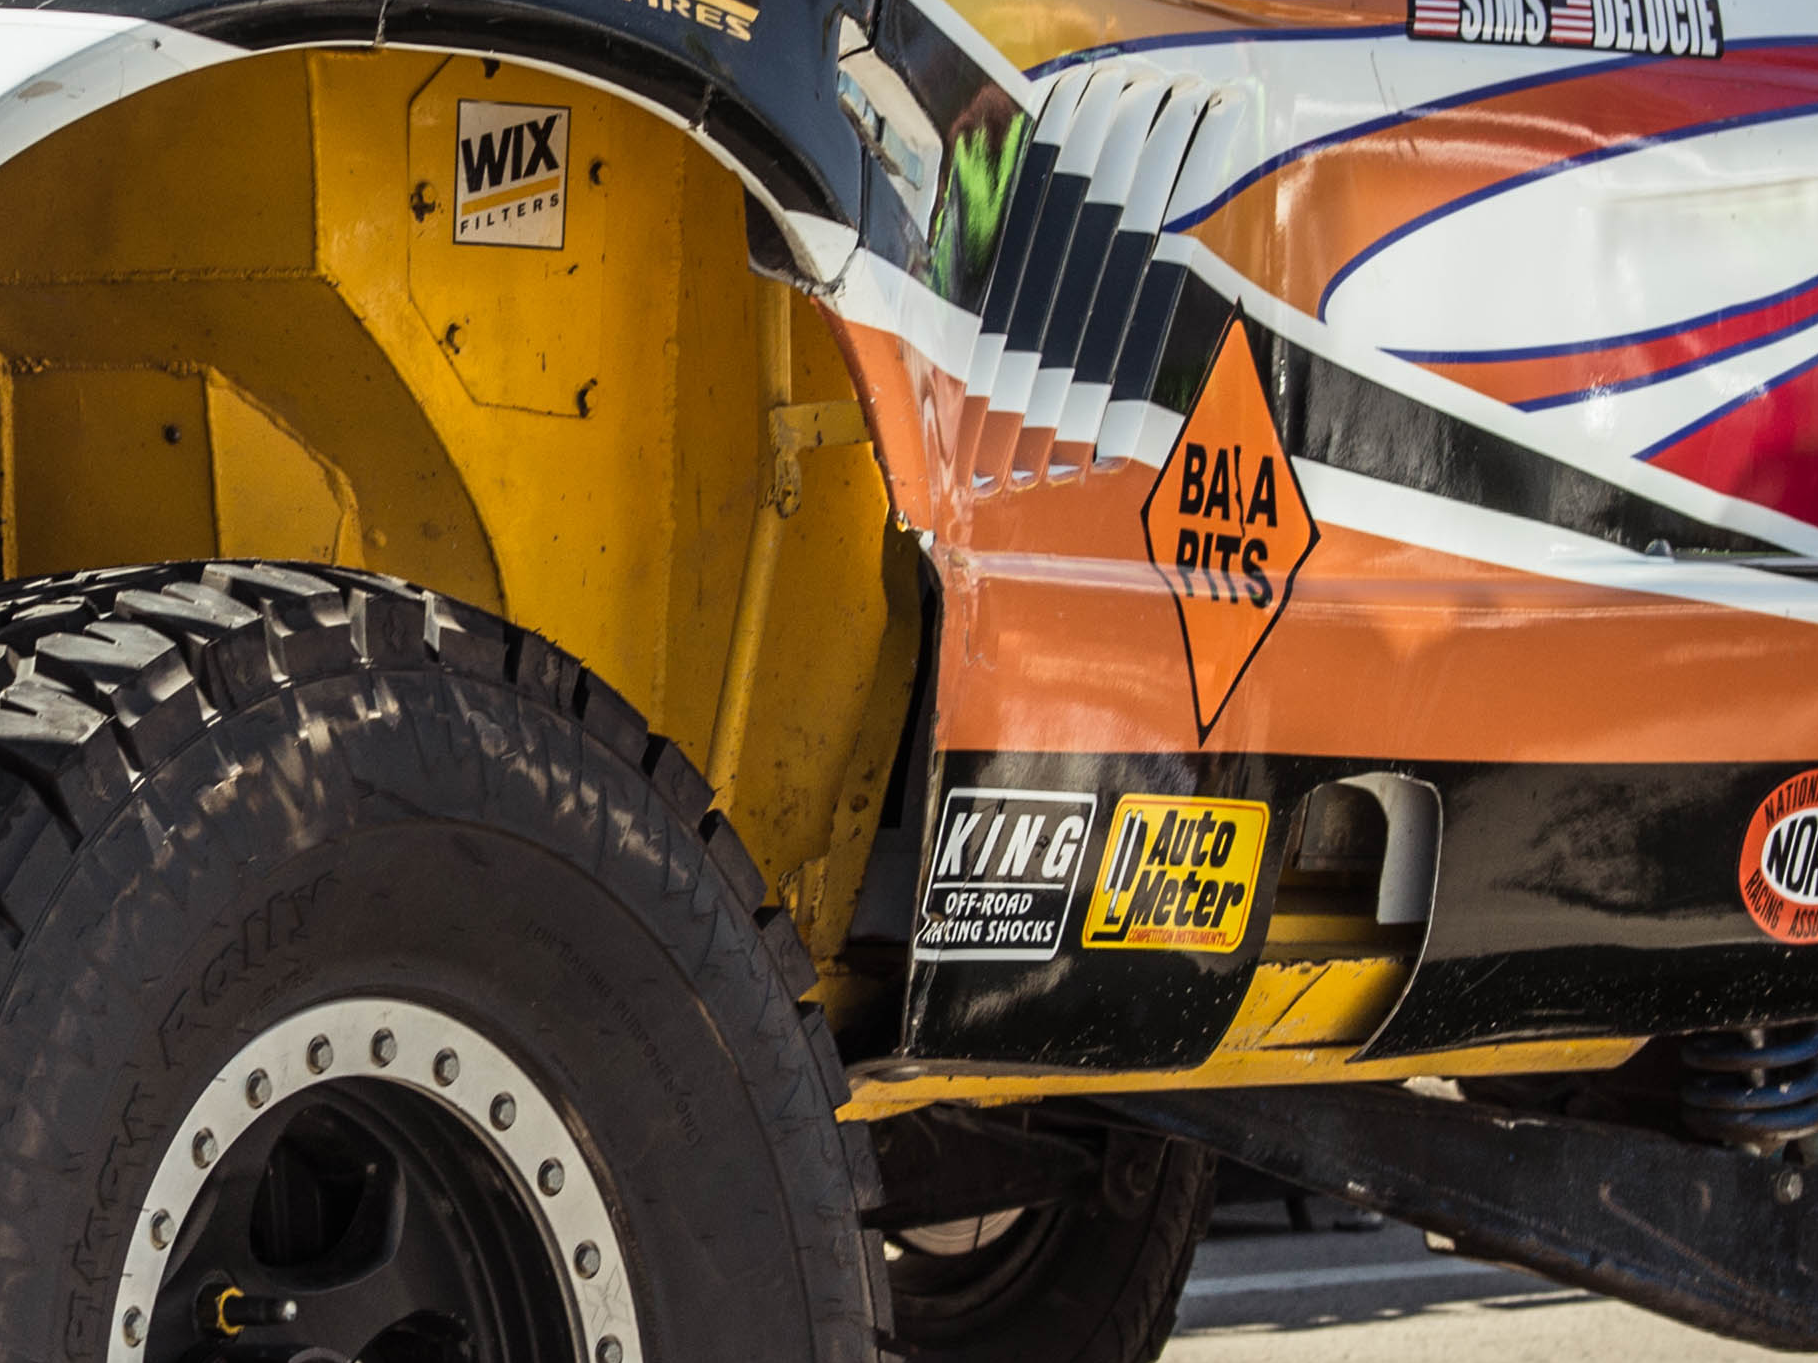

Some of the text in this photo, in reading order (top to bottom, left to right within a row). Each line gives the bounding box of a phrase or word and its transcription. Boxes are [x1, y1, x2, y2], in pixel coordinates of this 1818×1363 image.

[460, 113, 561, 194] WIX
[459, 192, 562, 237] FILTERS
[1175, 527, 1274, 610] PITS
[937, 812, 1086, 879] KING
[1145, 809, 1237, 869] Auto
[944, 891, 1035, 917] OFF-ROAD
[1132, 870, 1246, 931] Meter
[1744, 869, 1785, 932] RACING
[923, 920, 1056, 946] RACING SHOCKS
